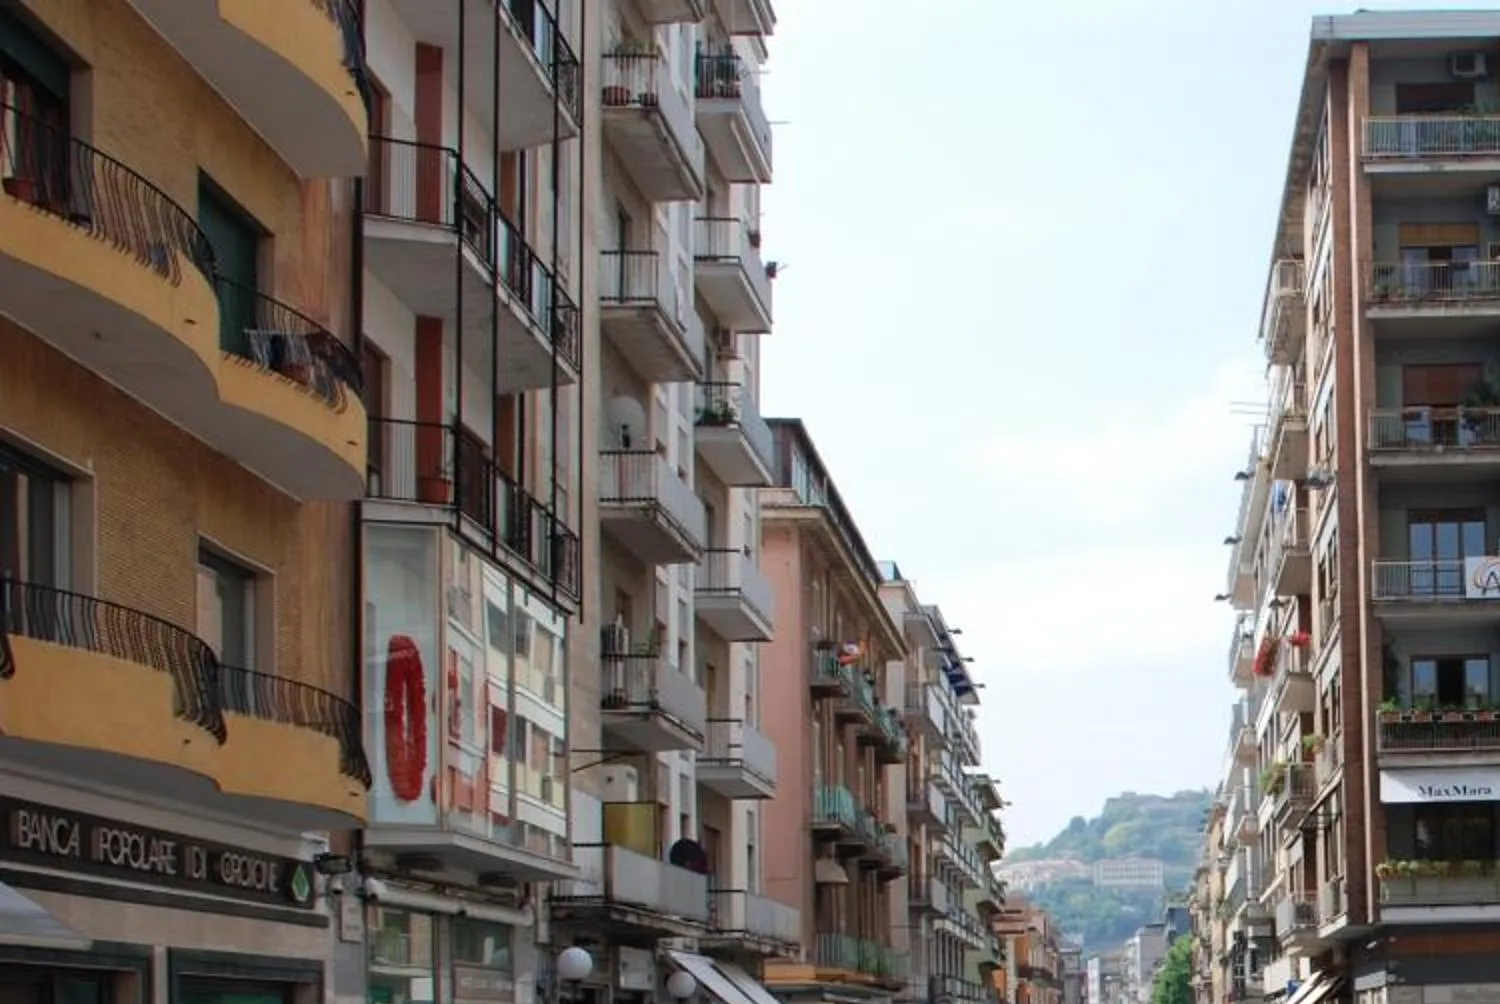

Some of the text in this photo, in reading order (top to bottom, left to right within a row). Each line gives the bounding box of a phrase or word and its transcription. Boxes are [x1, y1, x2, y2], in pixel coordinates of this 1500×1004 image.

[1418, 784, 1492, 797] MaxMara
[17, 810, 80, 856] BANCA
[98, 827, 177, 876] POPOLARE
[190, 846, 207, 879] DI
